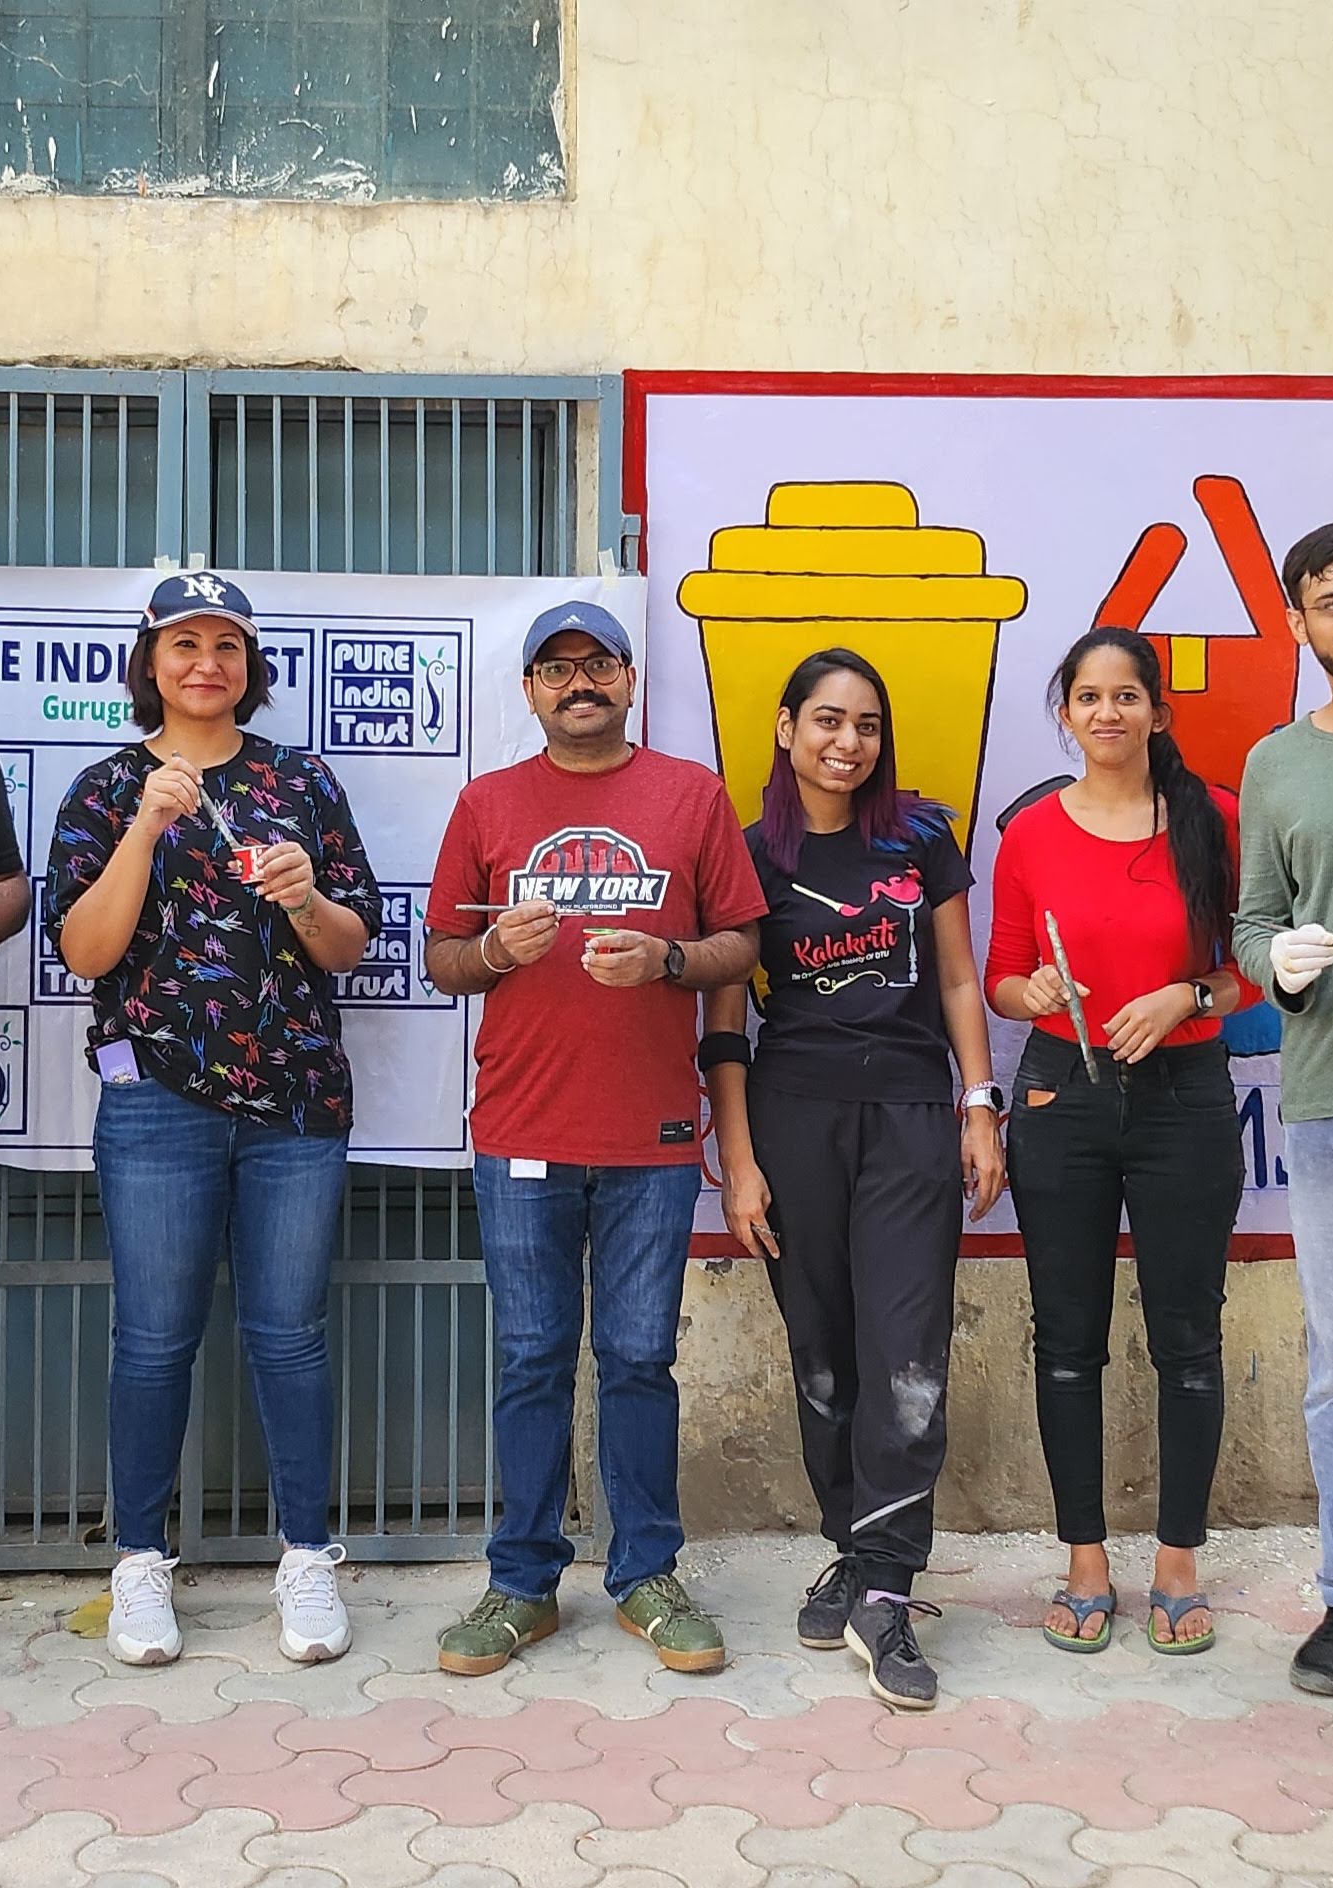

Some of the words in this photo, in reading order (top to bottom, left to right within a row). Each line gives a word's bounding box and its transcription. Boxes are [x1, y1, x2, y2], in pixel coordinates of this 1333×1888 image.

[180, 574, 227, 606] NY
[35, 641, 127, 684] INDI
[334, 643, 410, 671] PURE
[333, 679, 411, 707] India
[42, 695, 135, 729] Gurugr
[334, 714, 409, 745] Trust
[518, 877, 583, 901] NEW
[588, 877, 659, 901] YORK
[382, 897, 407, 924] RE
[363, 932, 407, 960] dia
[793, 917, 901, 969] Kalakriti
[874, 950, 890, 960] DTU
[44, 964, 95, 994] Tru
[331, 969, 406, 997] Trust
